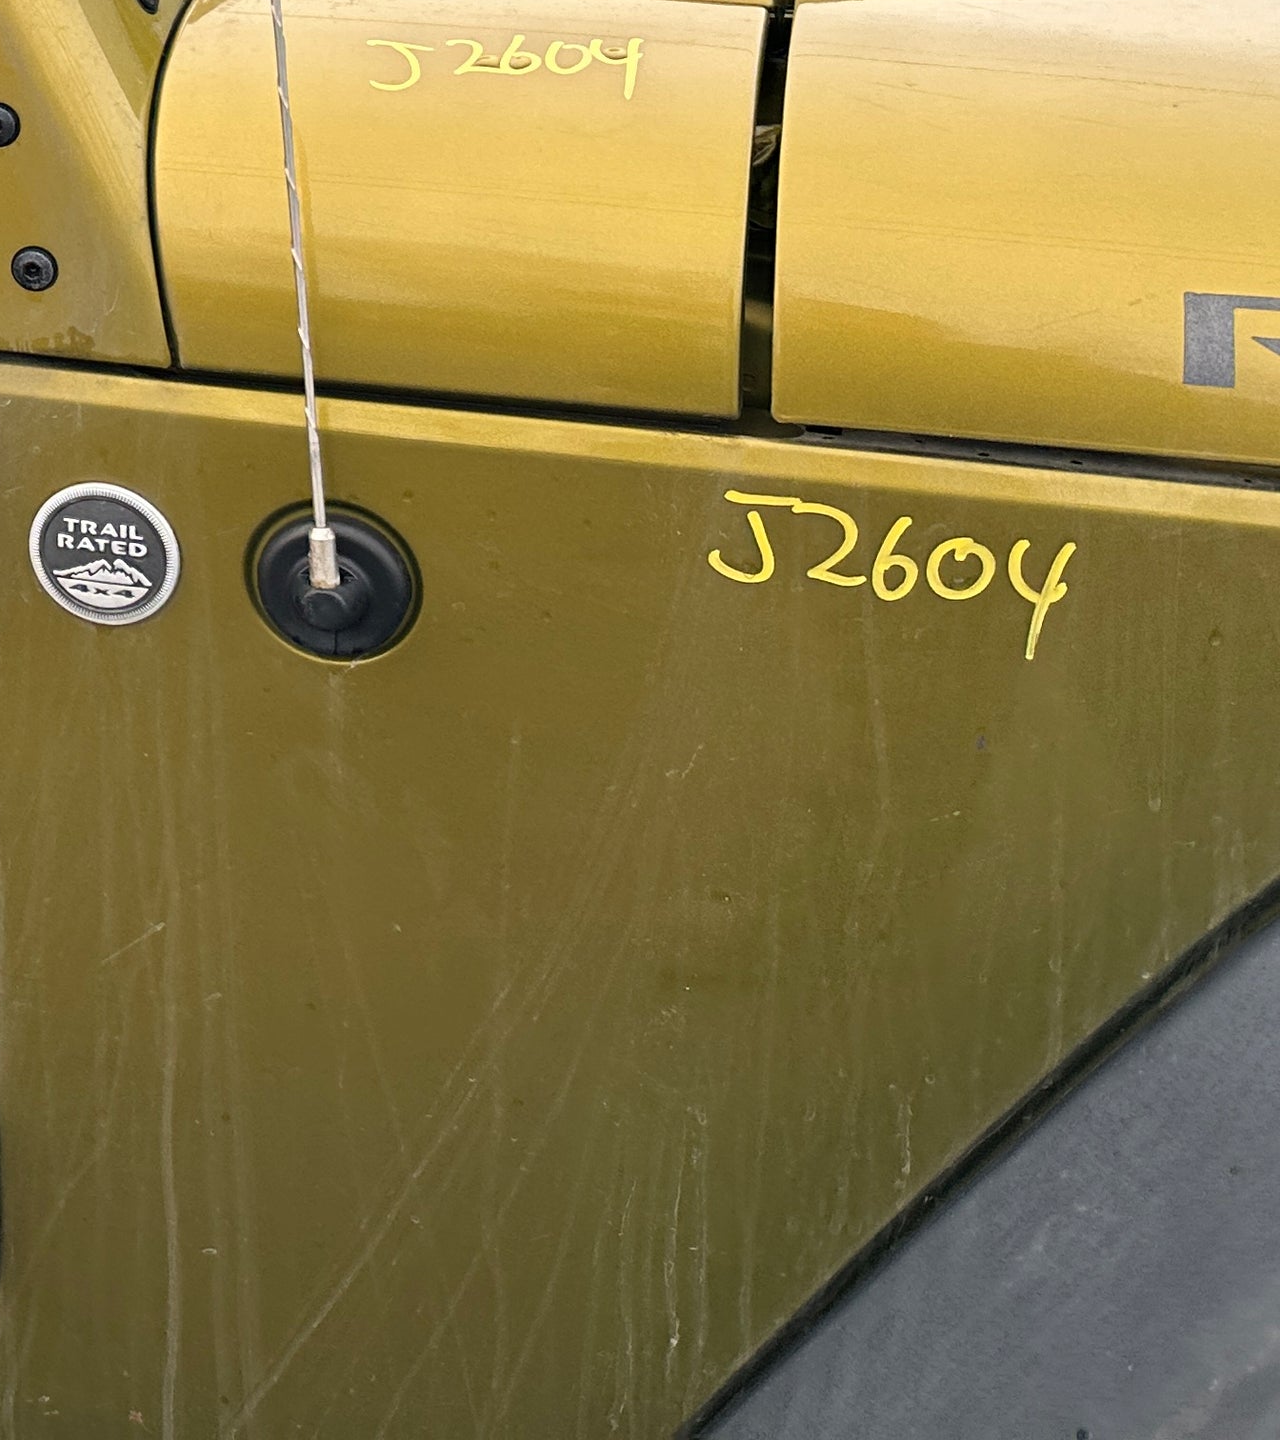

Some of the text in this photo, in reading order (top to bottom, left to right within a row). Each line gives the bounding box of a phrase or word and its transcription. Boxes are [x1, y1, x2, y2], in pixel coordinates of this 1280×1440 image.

[366, 34, 644, 100] J2604
[57, 533, 148, 558] RATED
[63, 517, 144, 541] TRAIL
[708, 489, 1077, 660] J2604
